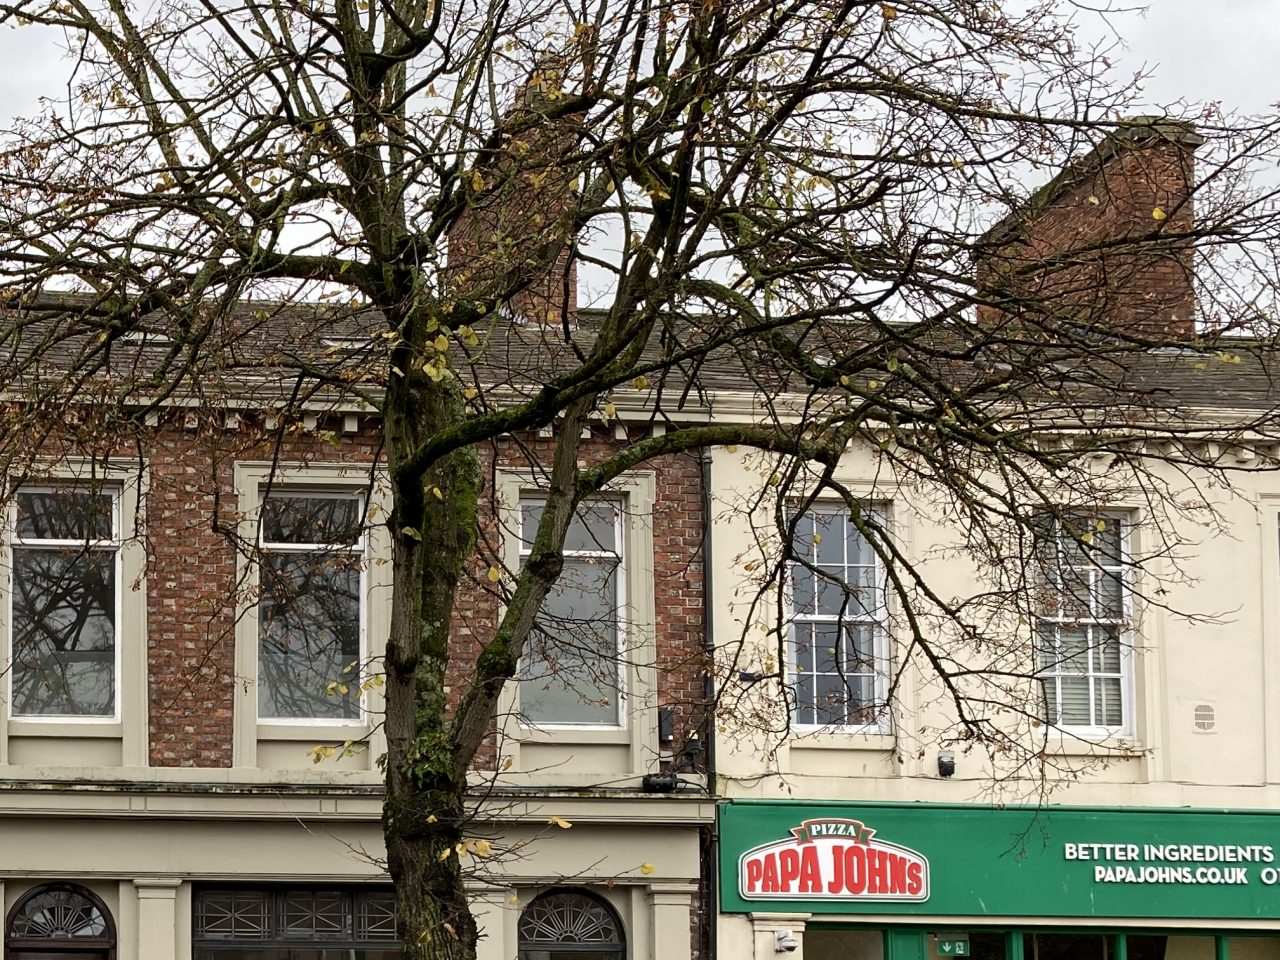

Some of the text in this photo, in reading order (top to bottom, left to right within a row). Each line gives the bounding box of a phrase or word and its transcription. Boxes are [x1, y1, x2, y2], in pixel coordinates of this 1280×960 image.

[811, 823, 856, 837] PIZZA
[1065, 843, 1274, 863] BETTER INGREDIENTS
[747, 845, 922, 895] PAPA JOHN'S
[1094, 866, 1280, 885] PAPAJOHNS.CO.UK 0
